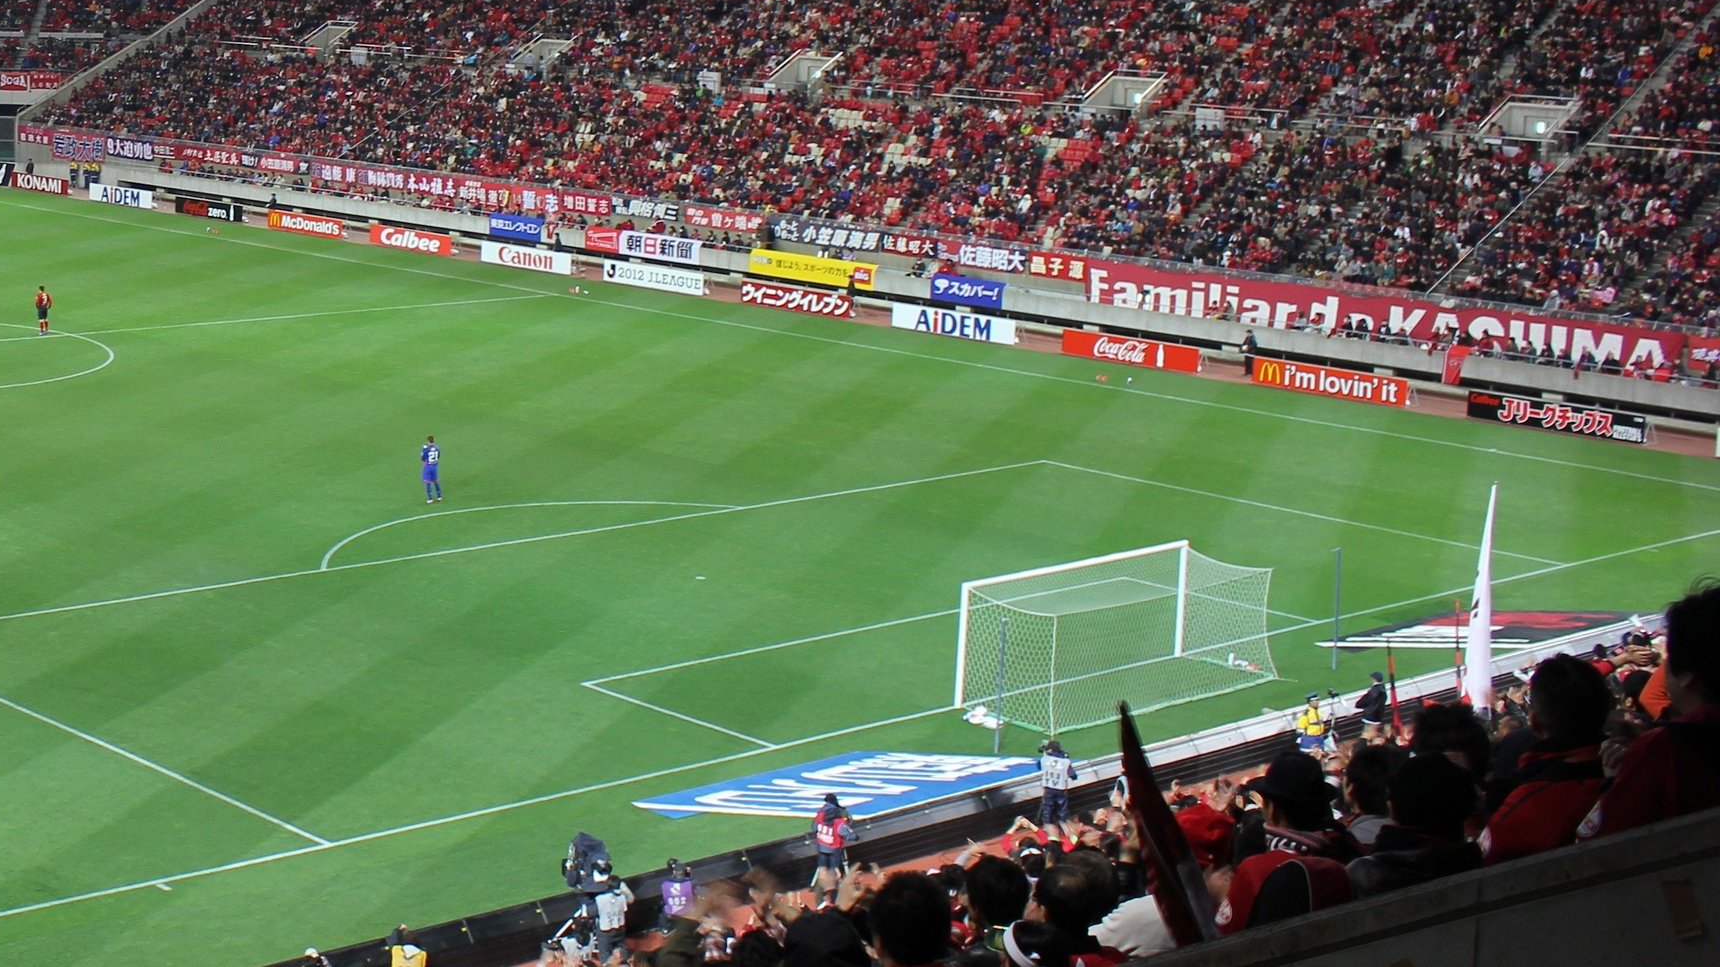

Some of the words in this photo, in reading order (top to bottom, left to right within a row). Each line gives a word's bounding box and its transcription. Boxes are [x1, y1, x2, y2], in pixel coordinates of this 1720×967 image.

[17, 175, 62, 194] KONAMI
[102, 186, 140, 207] AiDEM
[281, 215, 340, 236] McDonald's
[491, 219, 540, 235] 東京エレクトロン
[802, 225, 880, 251] 小笠原満男
[380, 228, 441, 253] Calbee
[626, 234, 694, 260] 朝日新聞
[883, 234, 935, 256] 佐藤昭大
[498, 245, 553, 271] Canon
[960, 244, 1025, 272] 佐藤昭大
[618, 266, 644, 281] 2012
[742, 283, 849, 316] ウイニングイレブン
[915, 309, 992, 341] AiDEM
[1388, 305, 1667, 370] KASHIMA
[1284, 364, 1319, 388] i'm
[1320, 366, 1379, 399] lovin'
[1381, 379, 1398, 403] it
[1498, 397, 1613, 436] Jリーグチップス
[428, 451, 439, 462] 21
